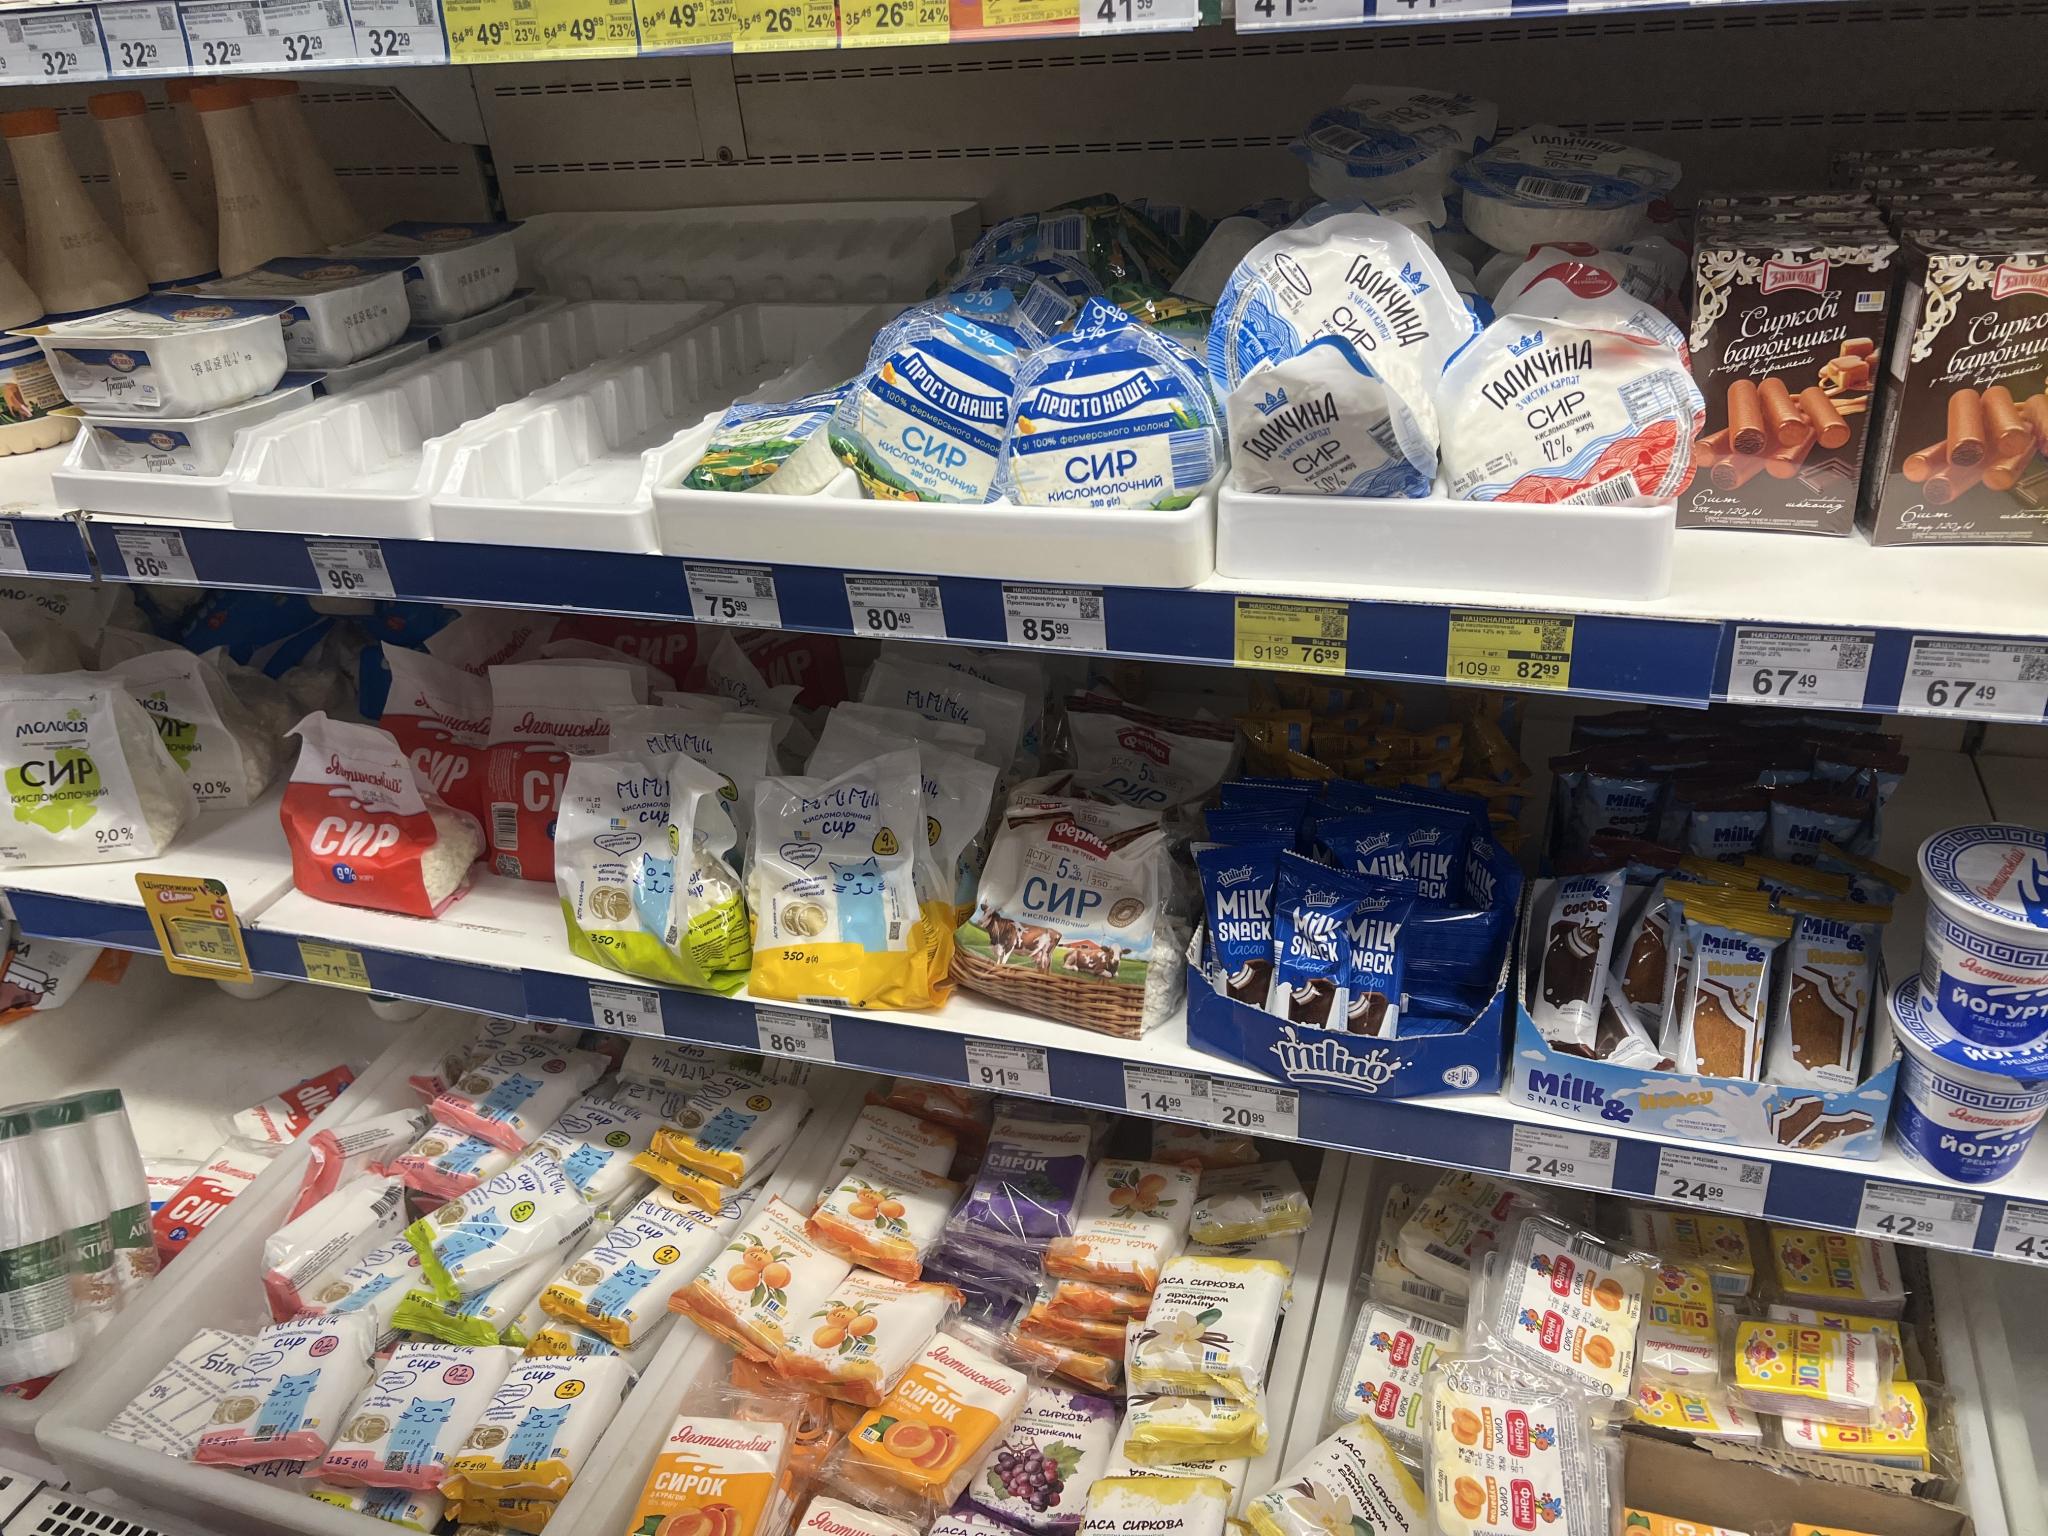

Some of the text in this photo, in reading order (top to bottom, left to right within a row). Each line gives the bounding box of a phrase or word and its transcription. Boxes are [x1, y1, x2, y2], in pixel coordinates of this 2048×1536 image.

[1345, 254, 1429, 348] ГАЛИЧИНА
[1091, 304, 1128, 325] 9%
[1741, 291, 1841, 342] Сиркові
[966, 322, 996, 348] 5%
[1332, 306, 1377, 352] СИР
[1969, 312, 2048, 350] Сирко
[1724, 325, 1848, 366] батончики
[1481, 339, 1592, 410] ГАЛИЧИНА
[887, 390, 971, 441] 100% фермерського
[1527, 391, 1586, 430] СИР
[1060, 426, 1129, 447] фермерського
[1242, 392, 1340, 462] ГАЛИЧИНА
[902, 426, 967, 470] СИР
[1293, 439, 1341, 475] СИР
[1543, 435, 1572, 462] 12%
[879, 440, 979, 497] КИСЛОМОЛОЧНИЙ
[1065, 449, 1137, 484] СИР
[1048, 475, 1163, 502] КИСЛОМОЛОЧНИЙ
[20, 758, 94, 788] СИР
[409, 747, 469, 794] СИР
[11, 787, 109, 804] КИСЛОМОЛОЧНИЙ
[311, 816, 400, 857] СИР
[336, 866, 358, 881] 9%
[1023, 875, 1102, 919] СИР
[1562, 899, 1608, 917] cocoa
[591, 933, 614, 946] 350
[1218, 920, 1272, 942] SNACK
[1801, 934, 1835, 945] SNACK
[783, 951, 804, 962] 350
[1228, 938, 1265, 956] Cacao
[1290, 936, 1338, 963] SNACK
[1701, 946, 1735, 957] SNACK
[1278, 1037, 1394, 1080] milino
[1527, 1092, 1581, 1112] SNACK
[1638, 1088, 1713, 1110] Honey
[587, 1110, 613, 1126] сир
[1940, 1133, 2030, 1158] ЙОГУРТ
[988, 1153, 1049, 1172] СИРОК
[518, 1173, 536, 1192] сир
[636, 1223, 664, 1241] сир
[1125, 1239, 1158, 1251] МАСА
[1190, 1278, 1246, 1291] СИРКОВА
[1167, 1291, 1230, 1305] ароматом
[274, 1335, 307, 1350] сир
[407, 1357, 440, 1372] сир
[1798, 1329, 1821, 1389] СИРОК
[523, 1368, 555, 1384] сир
[899, 1380, 963, 1423] СИРОК
[1039, 1409, 1093, 1425] СИРКОВА
[670, 1425, 773, 1452] Яготинський
[1013, 1424, 1082, 1443] родзинками
[326, 1456, 347, 1466] 185
[655, 1471, 727, 1497] СИРОК
[1334, 1435, 1410, 1535] МАСА СИРКОВА
[1123, 1518, 1184, 1532] СИРКОВА
